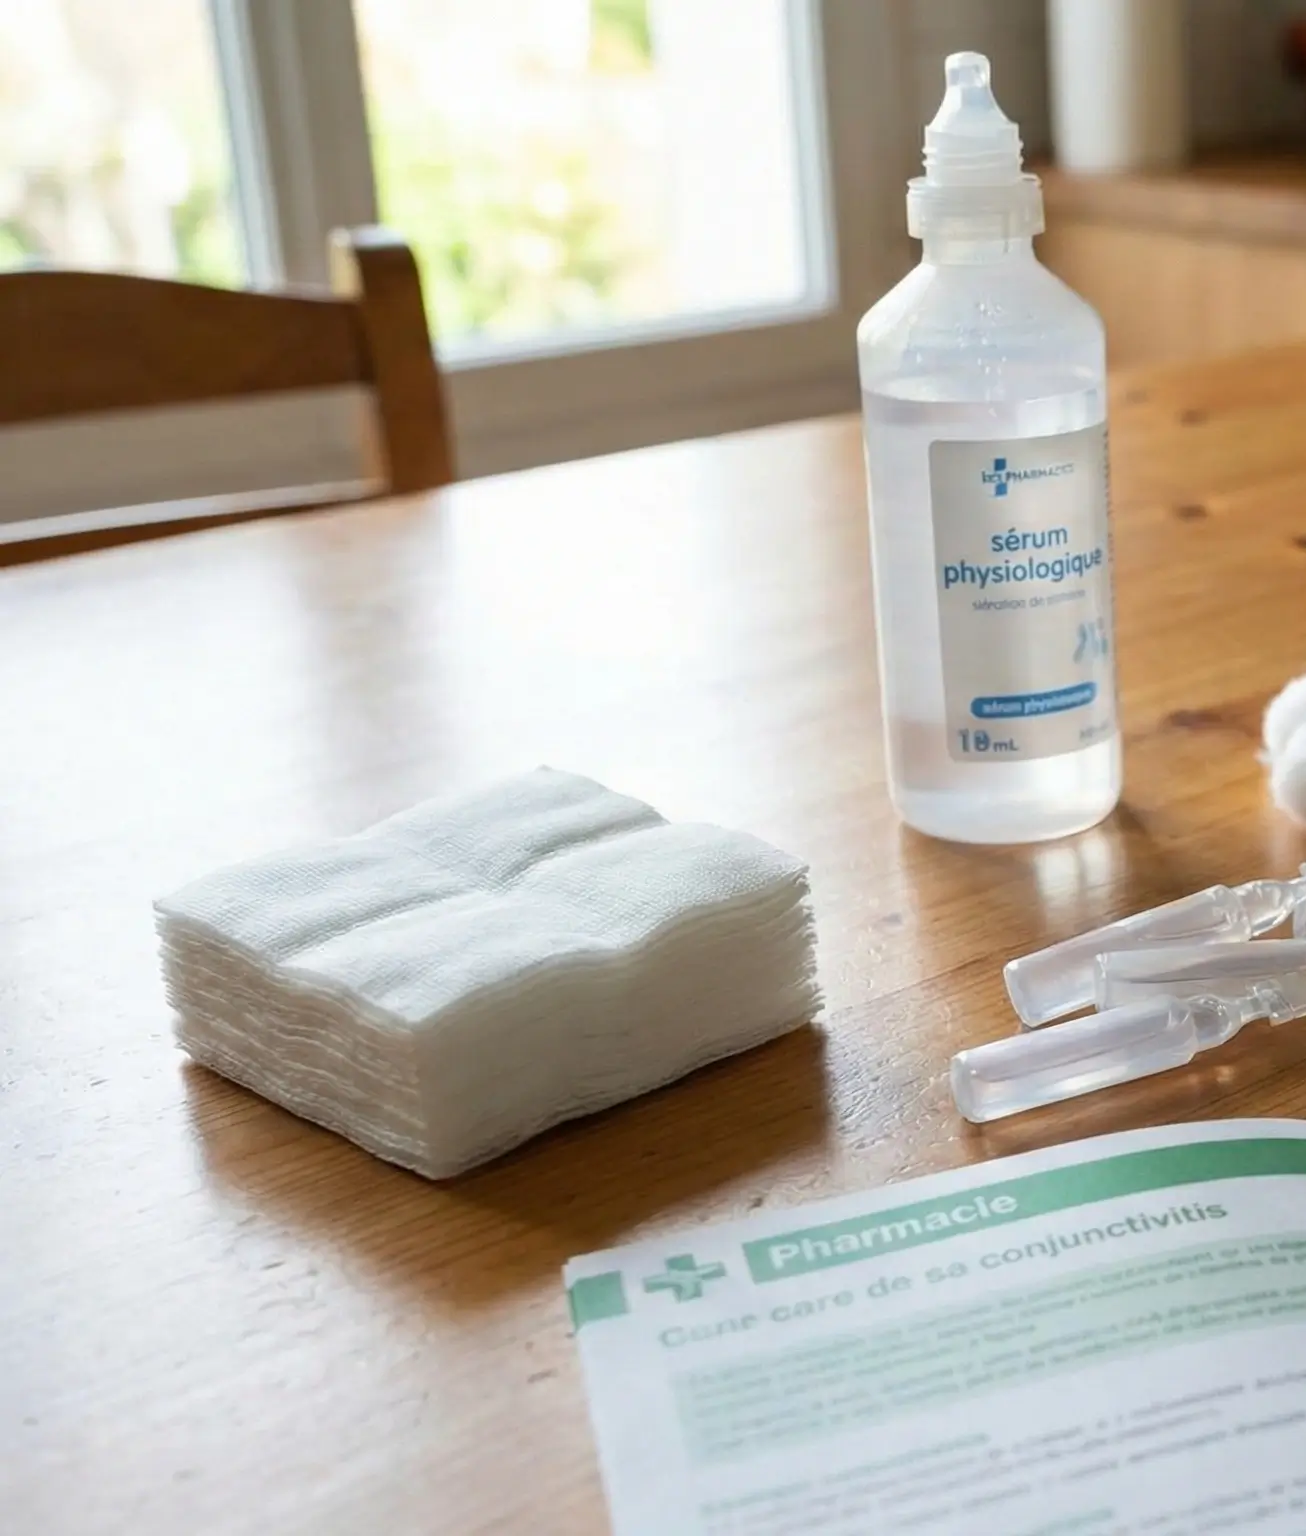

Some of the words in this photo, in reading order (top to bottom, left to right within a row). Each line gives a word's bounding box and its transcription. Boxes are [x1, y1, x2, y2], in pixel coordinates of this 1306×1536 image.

[991, 527, 1068, 553] sérum
[944, 548, 1103, 589] physiologique
[867, 1273, 913, 1299] de
[924, 1258, 969, 1284] sa
[978, 1199, 1230, 1270] conjunctivitis
